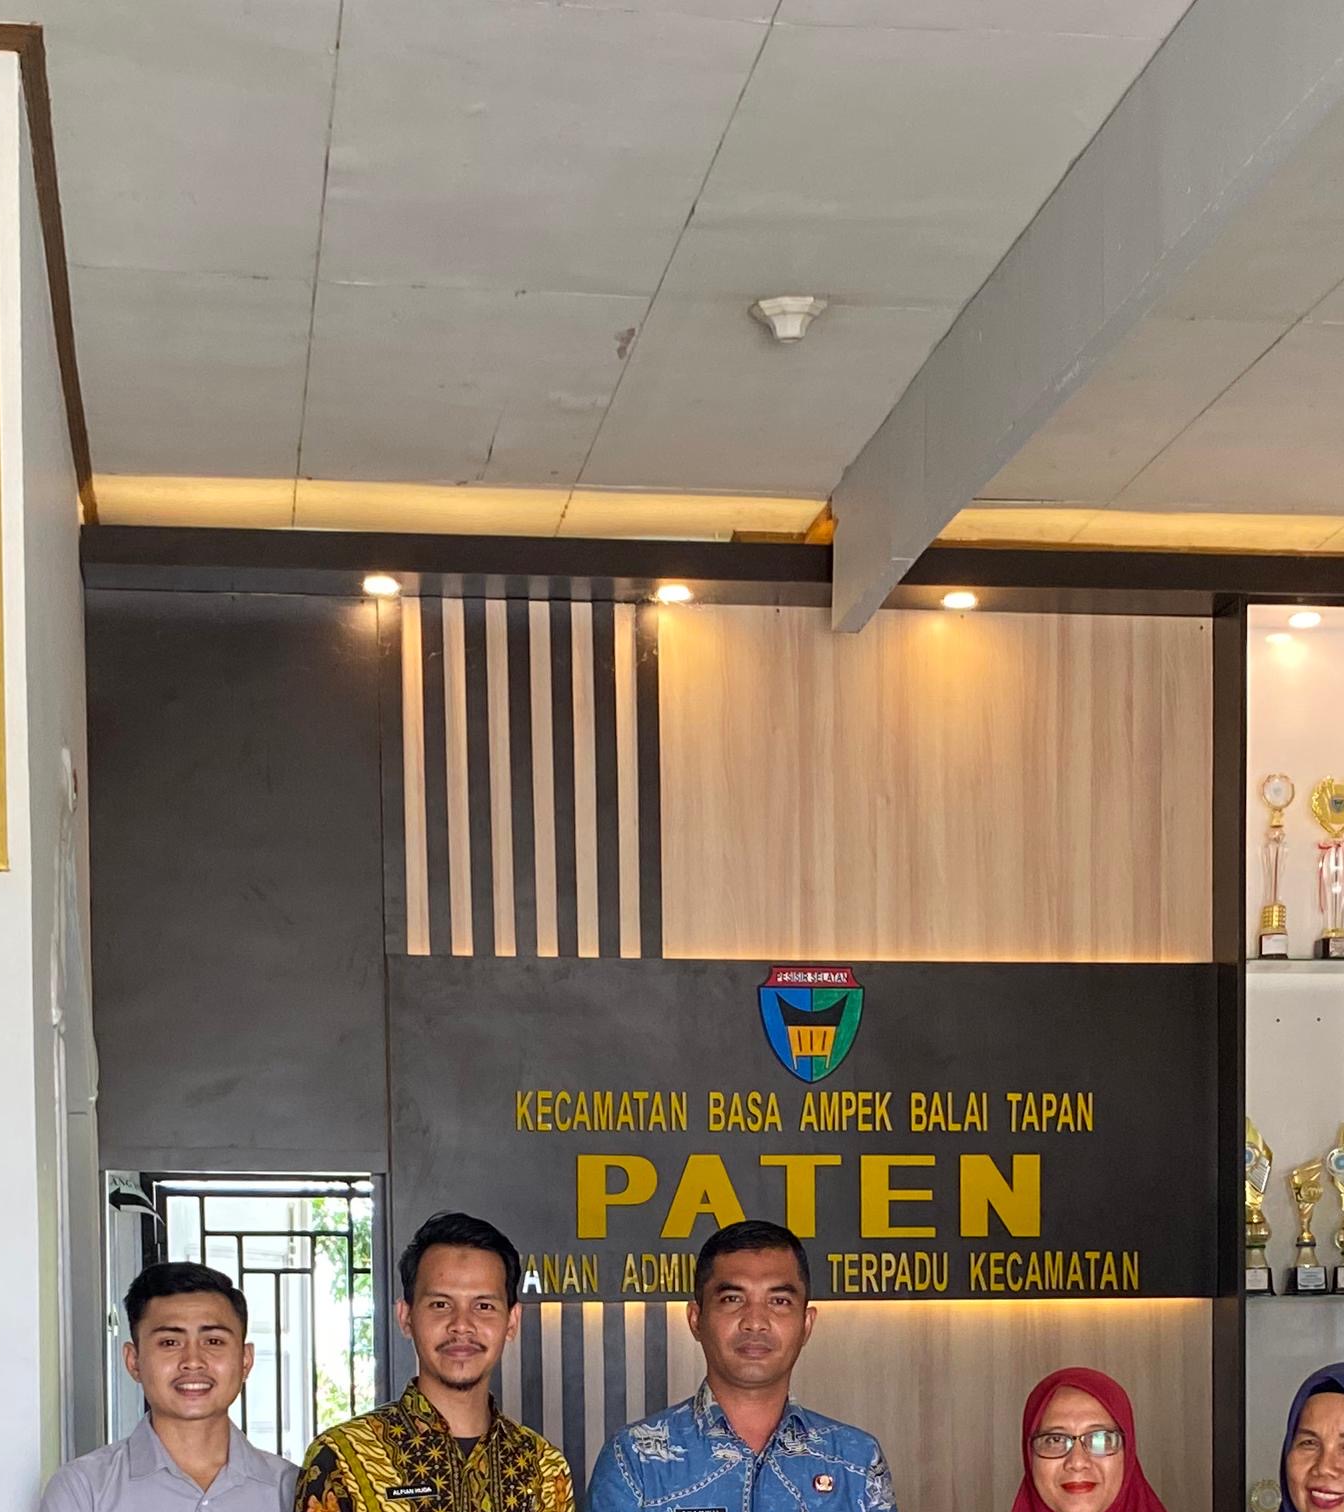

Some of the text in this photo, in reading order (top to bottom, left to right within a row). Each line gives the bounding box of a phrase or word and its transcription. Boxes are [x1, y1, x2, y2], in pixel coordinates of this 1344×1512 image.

[517, 1090, 1094, 1132] KECAMATAN BASA AMPEK BALAI TAPAN
[576, 1154, 1041, 1239] PATEN
[827, 1253, 948, 1293] TERPADU
[969, 1251, 1139, 1292] KECAMATAN
